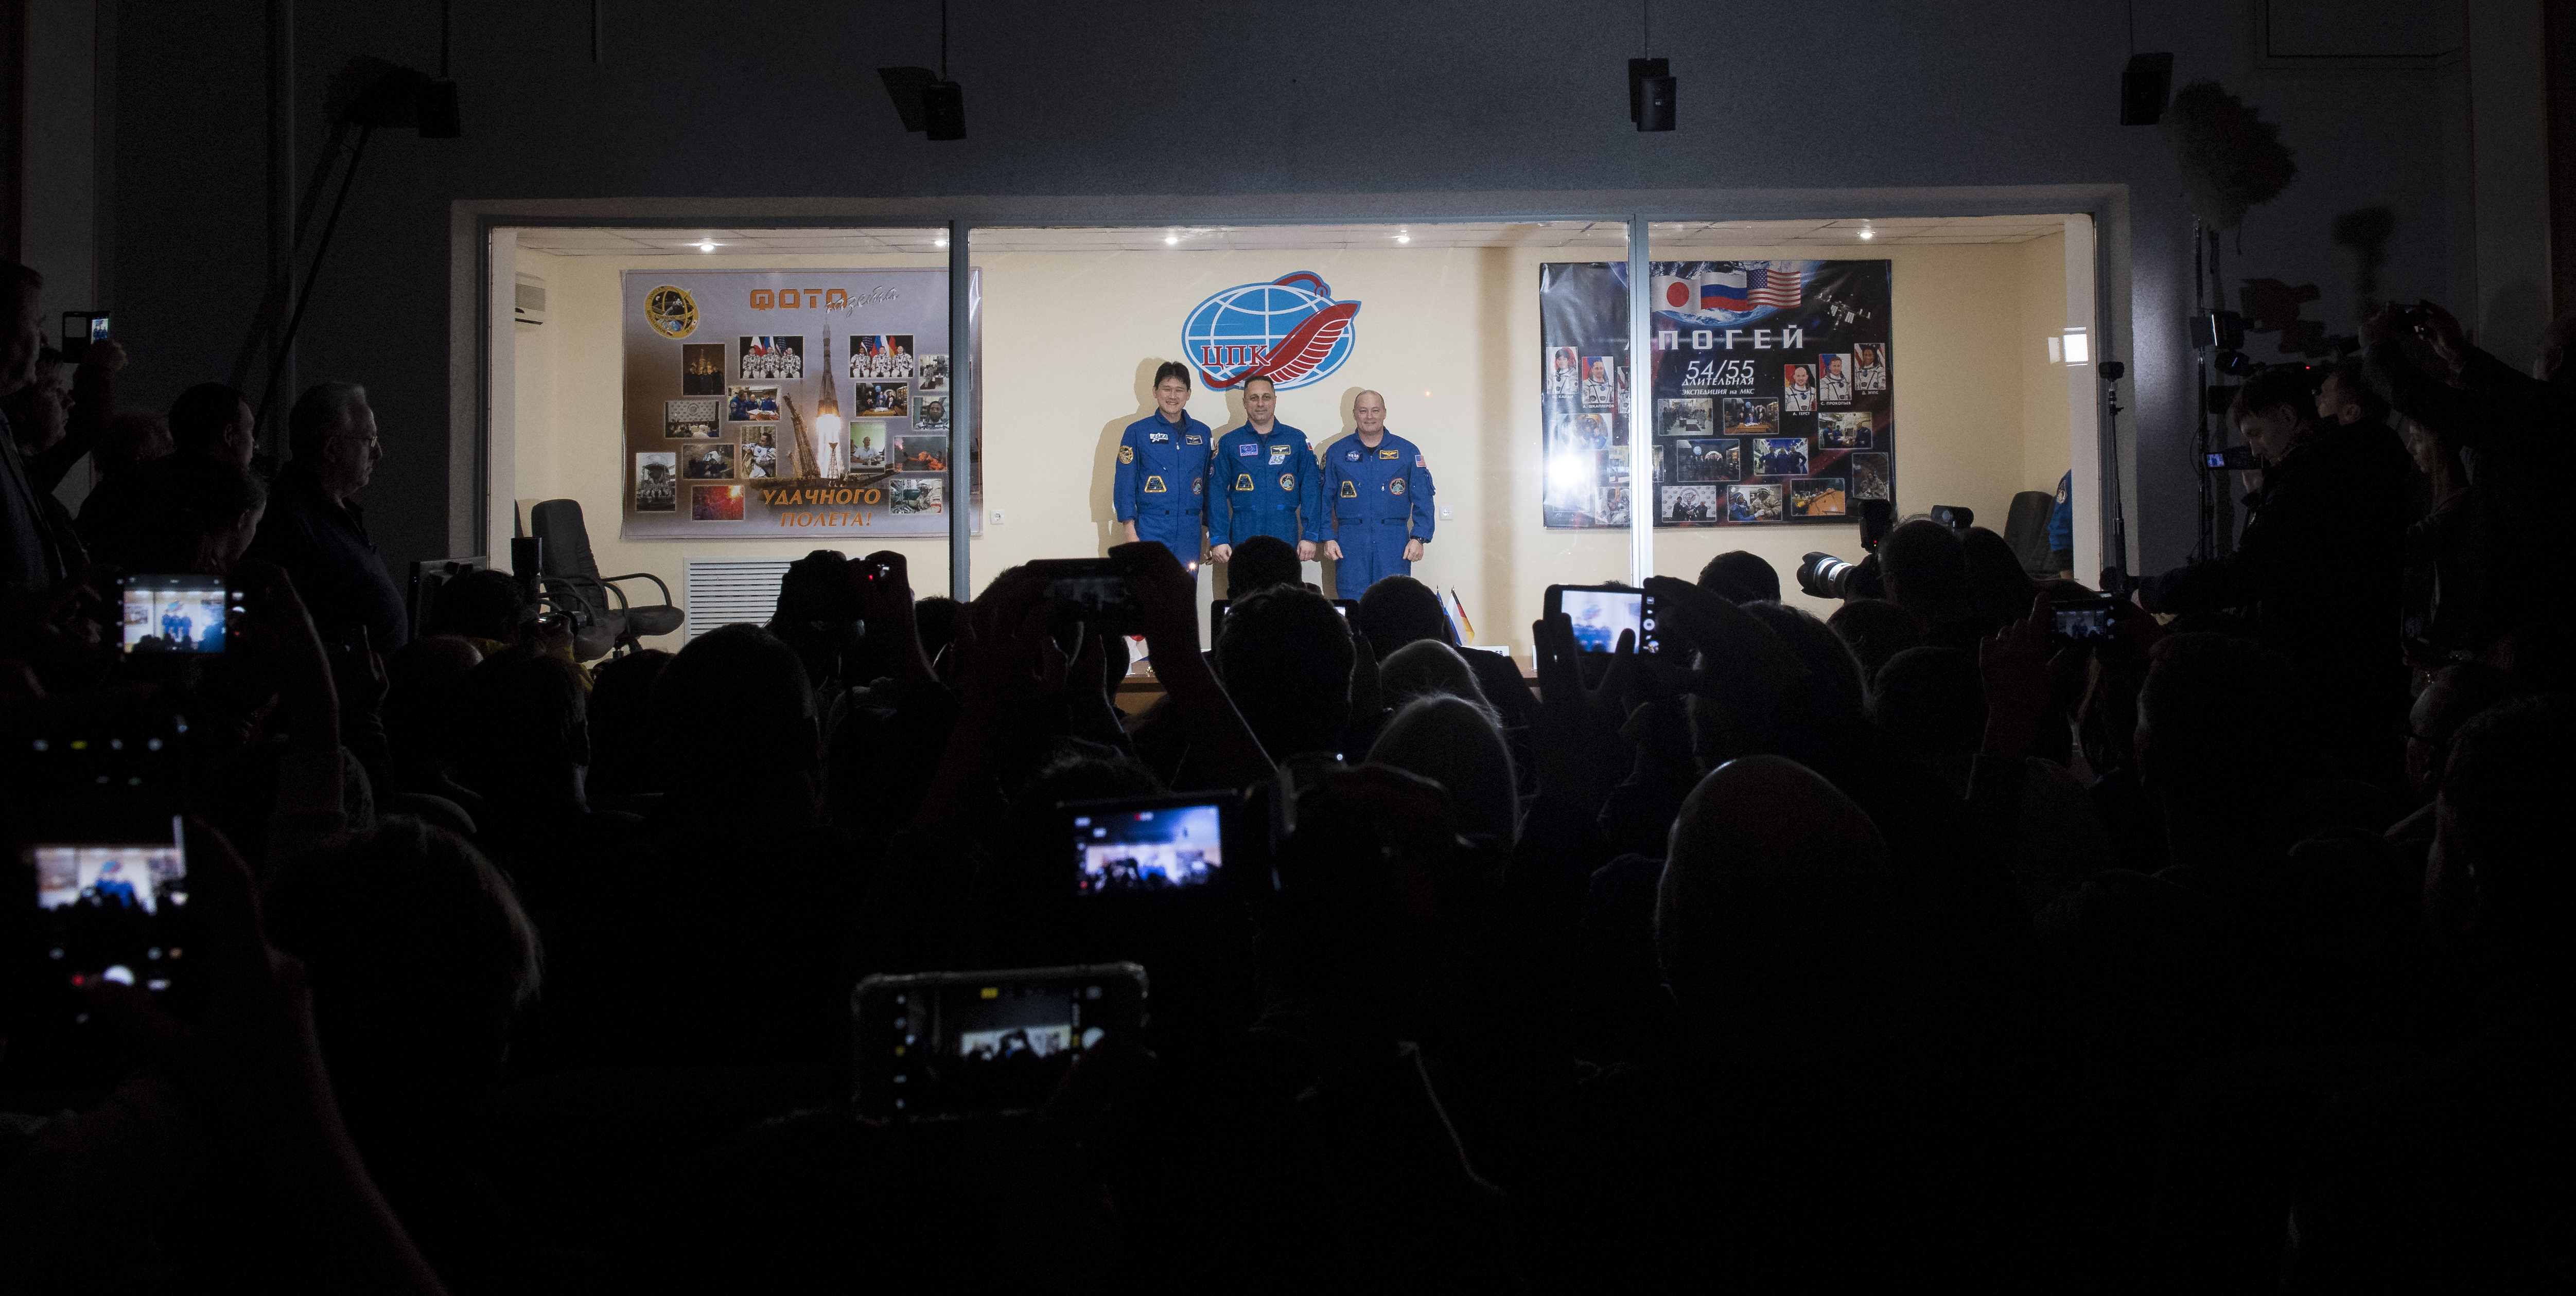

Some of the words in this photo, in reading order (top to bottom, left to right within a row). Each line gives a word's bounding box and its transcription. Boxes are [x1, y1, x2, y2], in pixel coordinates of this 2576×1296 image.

[1624, 325, 1803, 350] ПОГЕЙ
[1201, 345, 1271, 370] ЦПК
[1686, 360, 1755, 380] 54/55
[1681, 378, 1754, 386] ДЛИТЕЛЬНАЯ
[763, 489, 881, 505] УДАЧНОГО
[781, 512, 872, 527] ПОЛЕТА!
